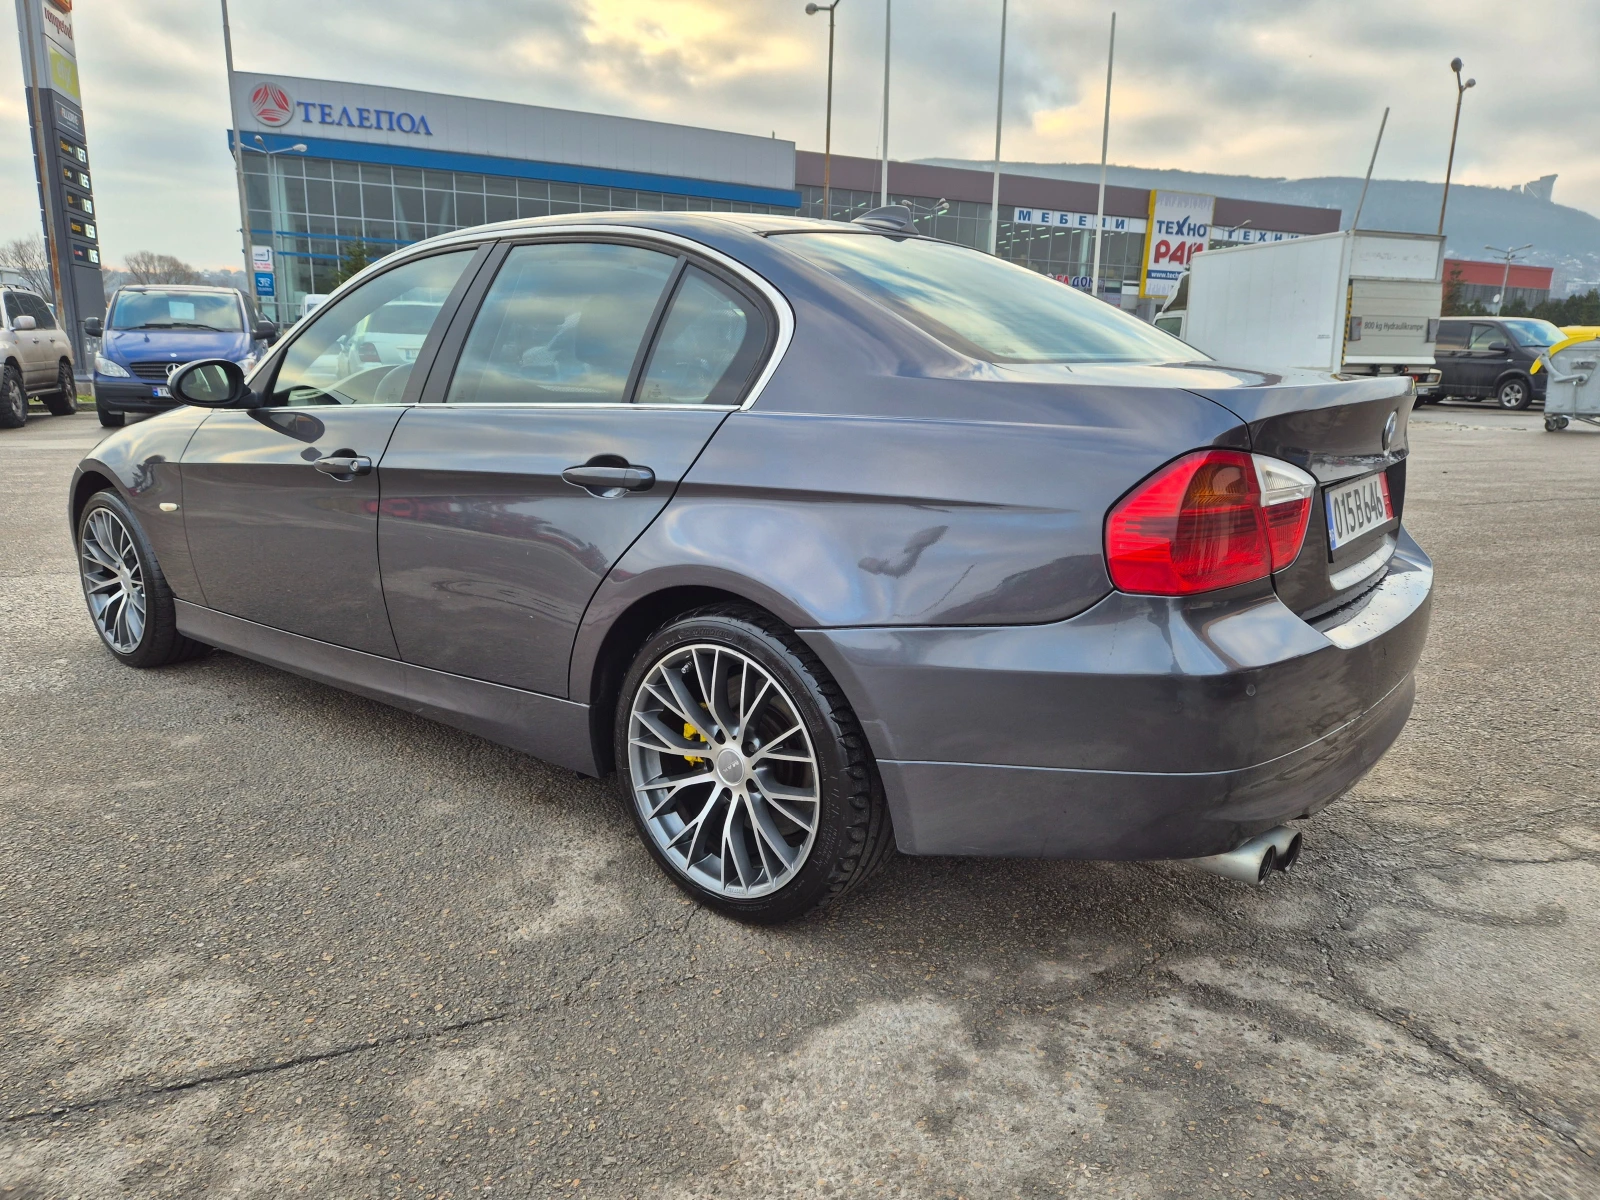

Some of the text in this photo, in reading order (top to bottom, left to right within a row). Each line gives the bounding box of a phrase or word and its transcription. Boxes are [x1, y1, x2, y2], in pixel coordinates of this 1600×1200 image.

[296, 100, 433, 136] ТЕЛЕПОЛ
[1156, 215, 1207, 237] ТЕХНО
[1363, 321, 1375, 330] 800
[1375, 322, 1383, 332] kg
